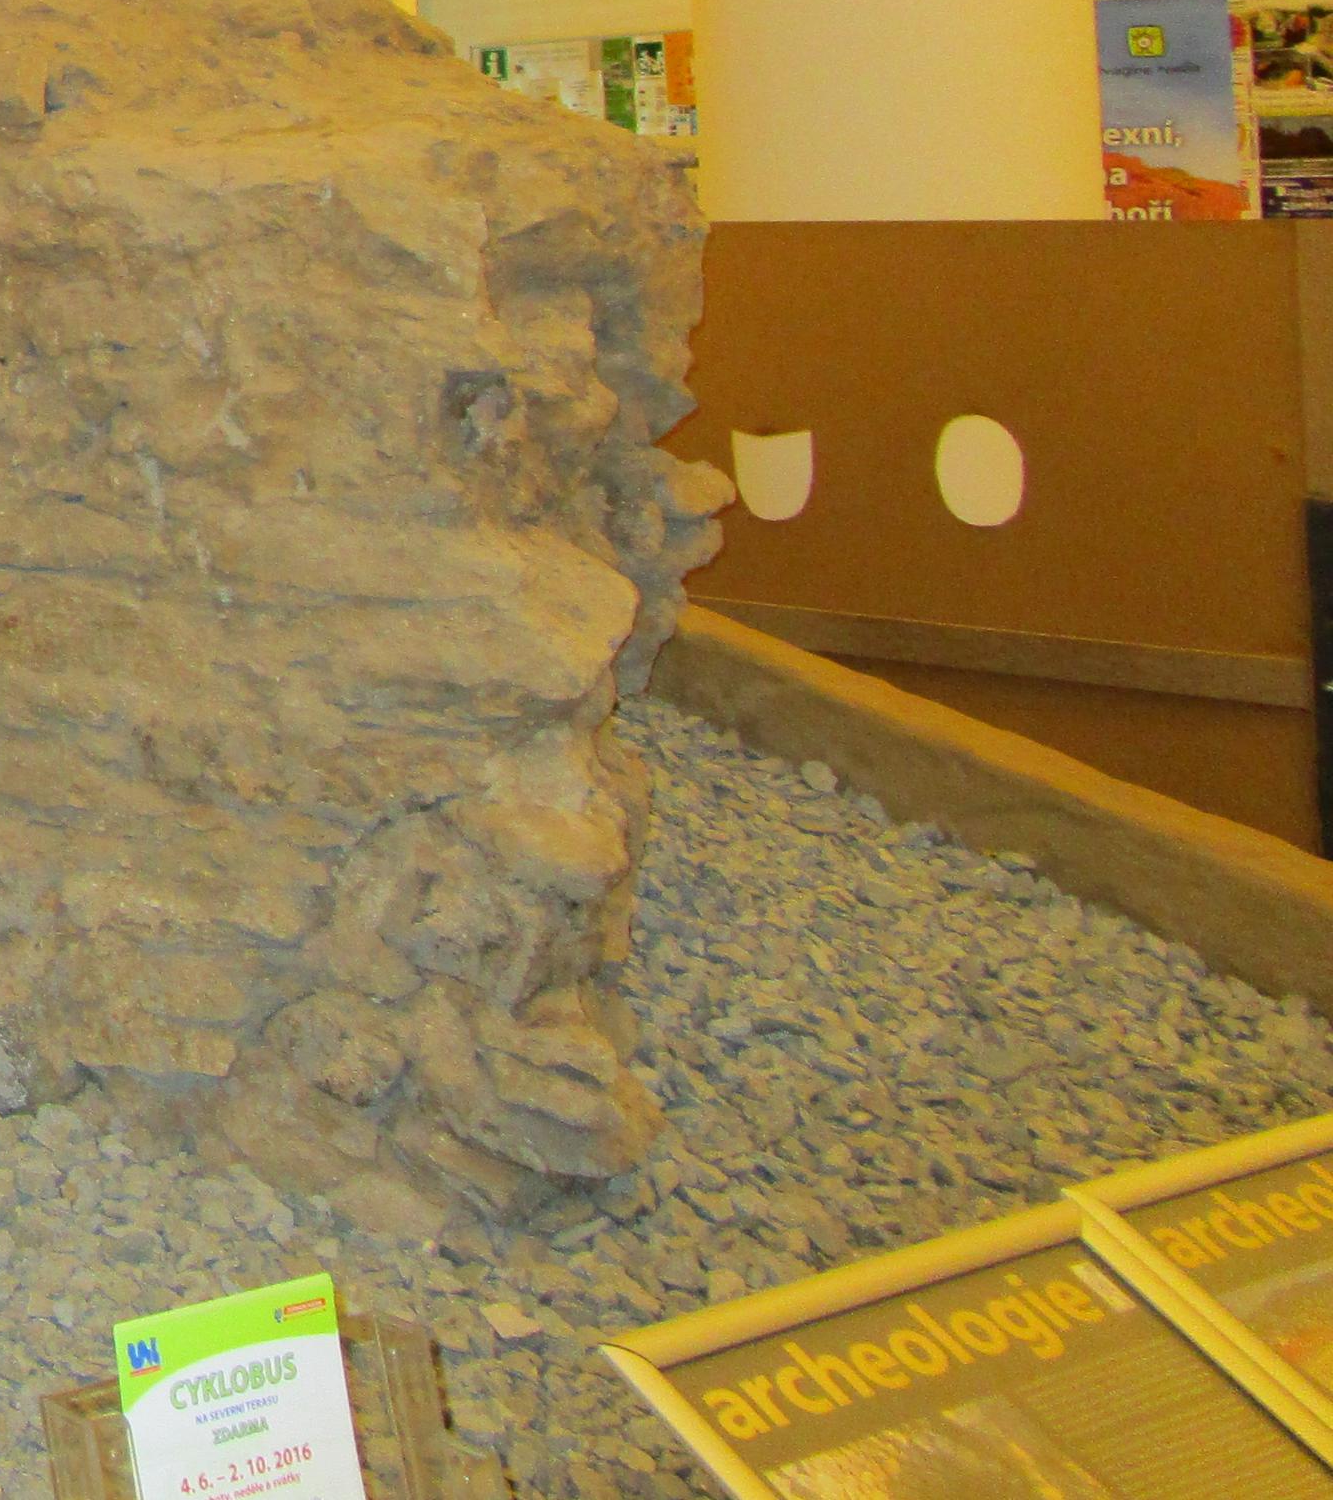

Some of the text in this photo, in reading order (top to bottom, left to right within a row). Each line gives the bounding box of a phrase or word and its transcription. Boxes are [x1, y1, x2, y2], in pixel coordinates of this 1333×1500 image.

[169, 1351, 298, 1410] CYKLOBUS
[702, 1274, 1105, 1440] archeologie
[195, 1413, 209, 1424] NA
[211, 1415, 269, 1445] ZDARMA
[181, 1477, 196, 1494] 4.
[198, 1472, 214, 1490] 6.
[229, 1463, 244, 1483] 2.
[247, 1455, 271, 1476] 10.
[273, 1443, 313, 1469] 2016
